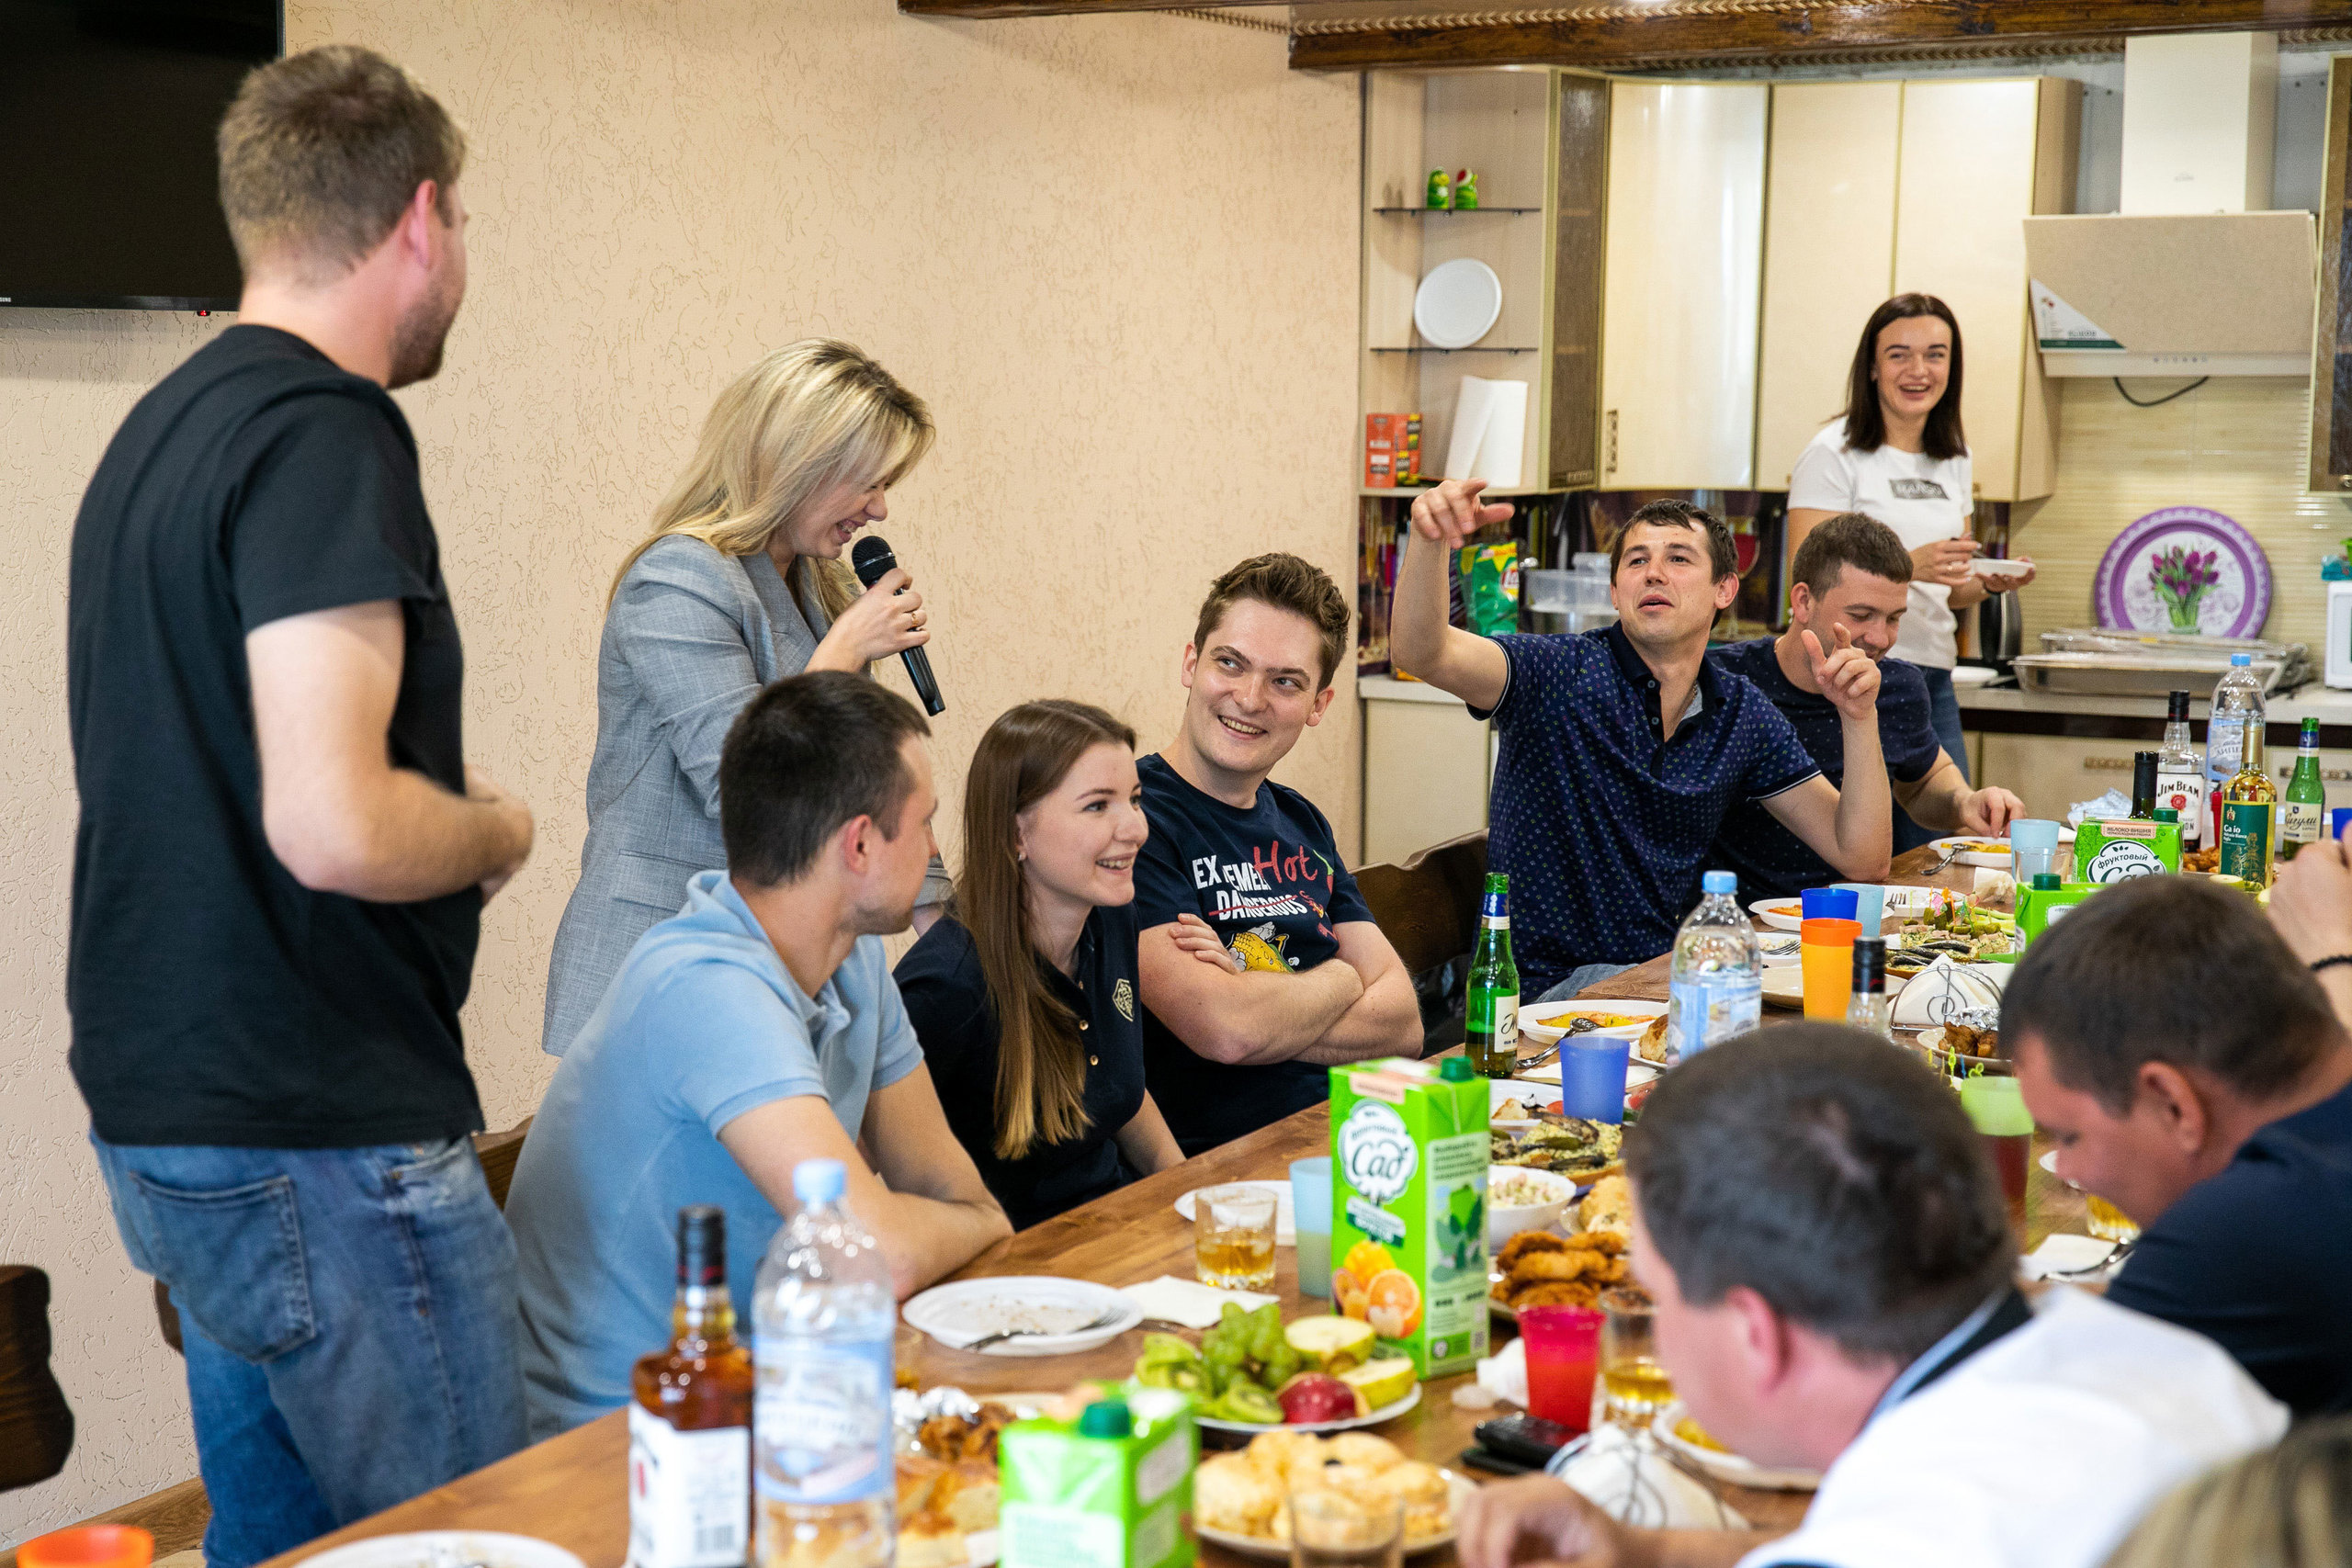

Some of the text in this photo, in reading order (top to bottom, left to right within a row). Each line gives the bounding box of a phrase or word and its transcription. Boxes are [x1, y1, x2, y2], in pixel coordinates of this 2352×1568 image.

[2157, 781, 2199, 798] JIM BEAM
[1253, 840, 1318, 884] Hot
[2098, 853, 2149, 870] фруктовый
[1351, 1138, 1404, 1180] Сад
